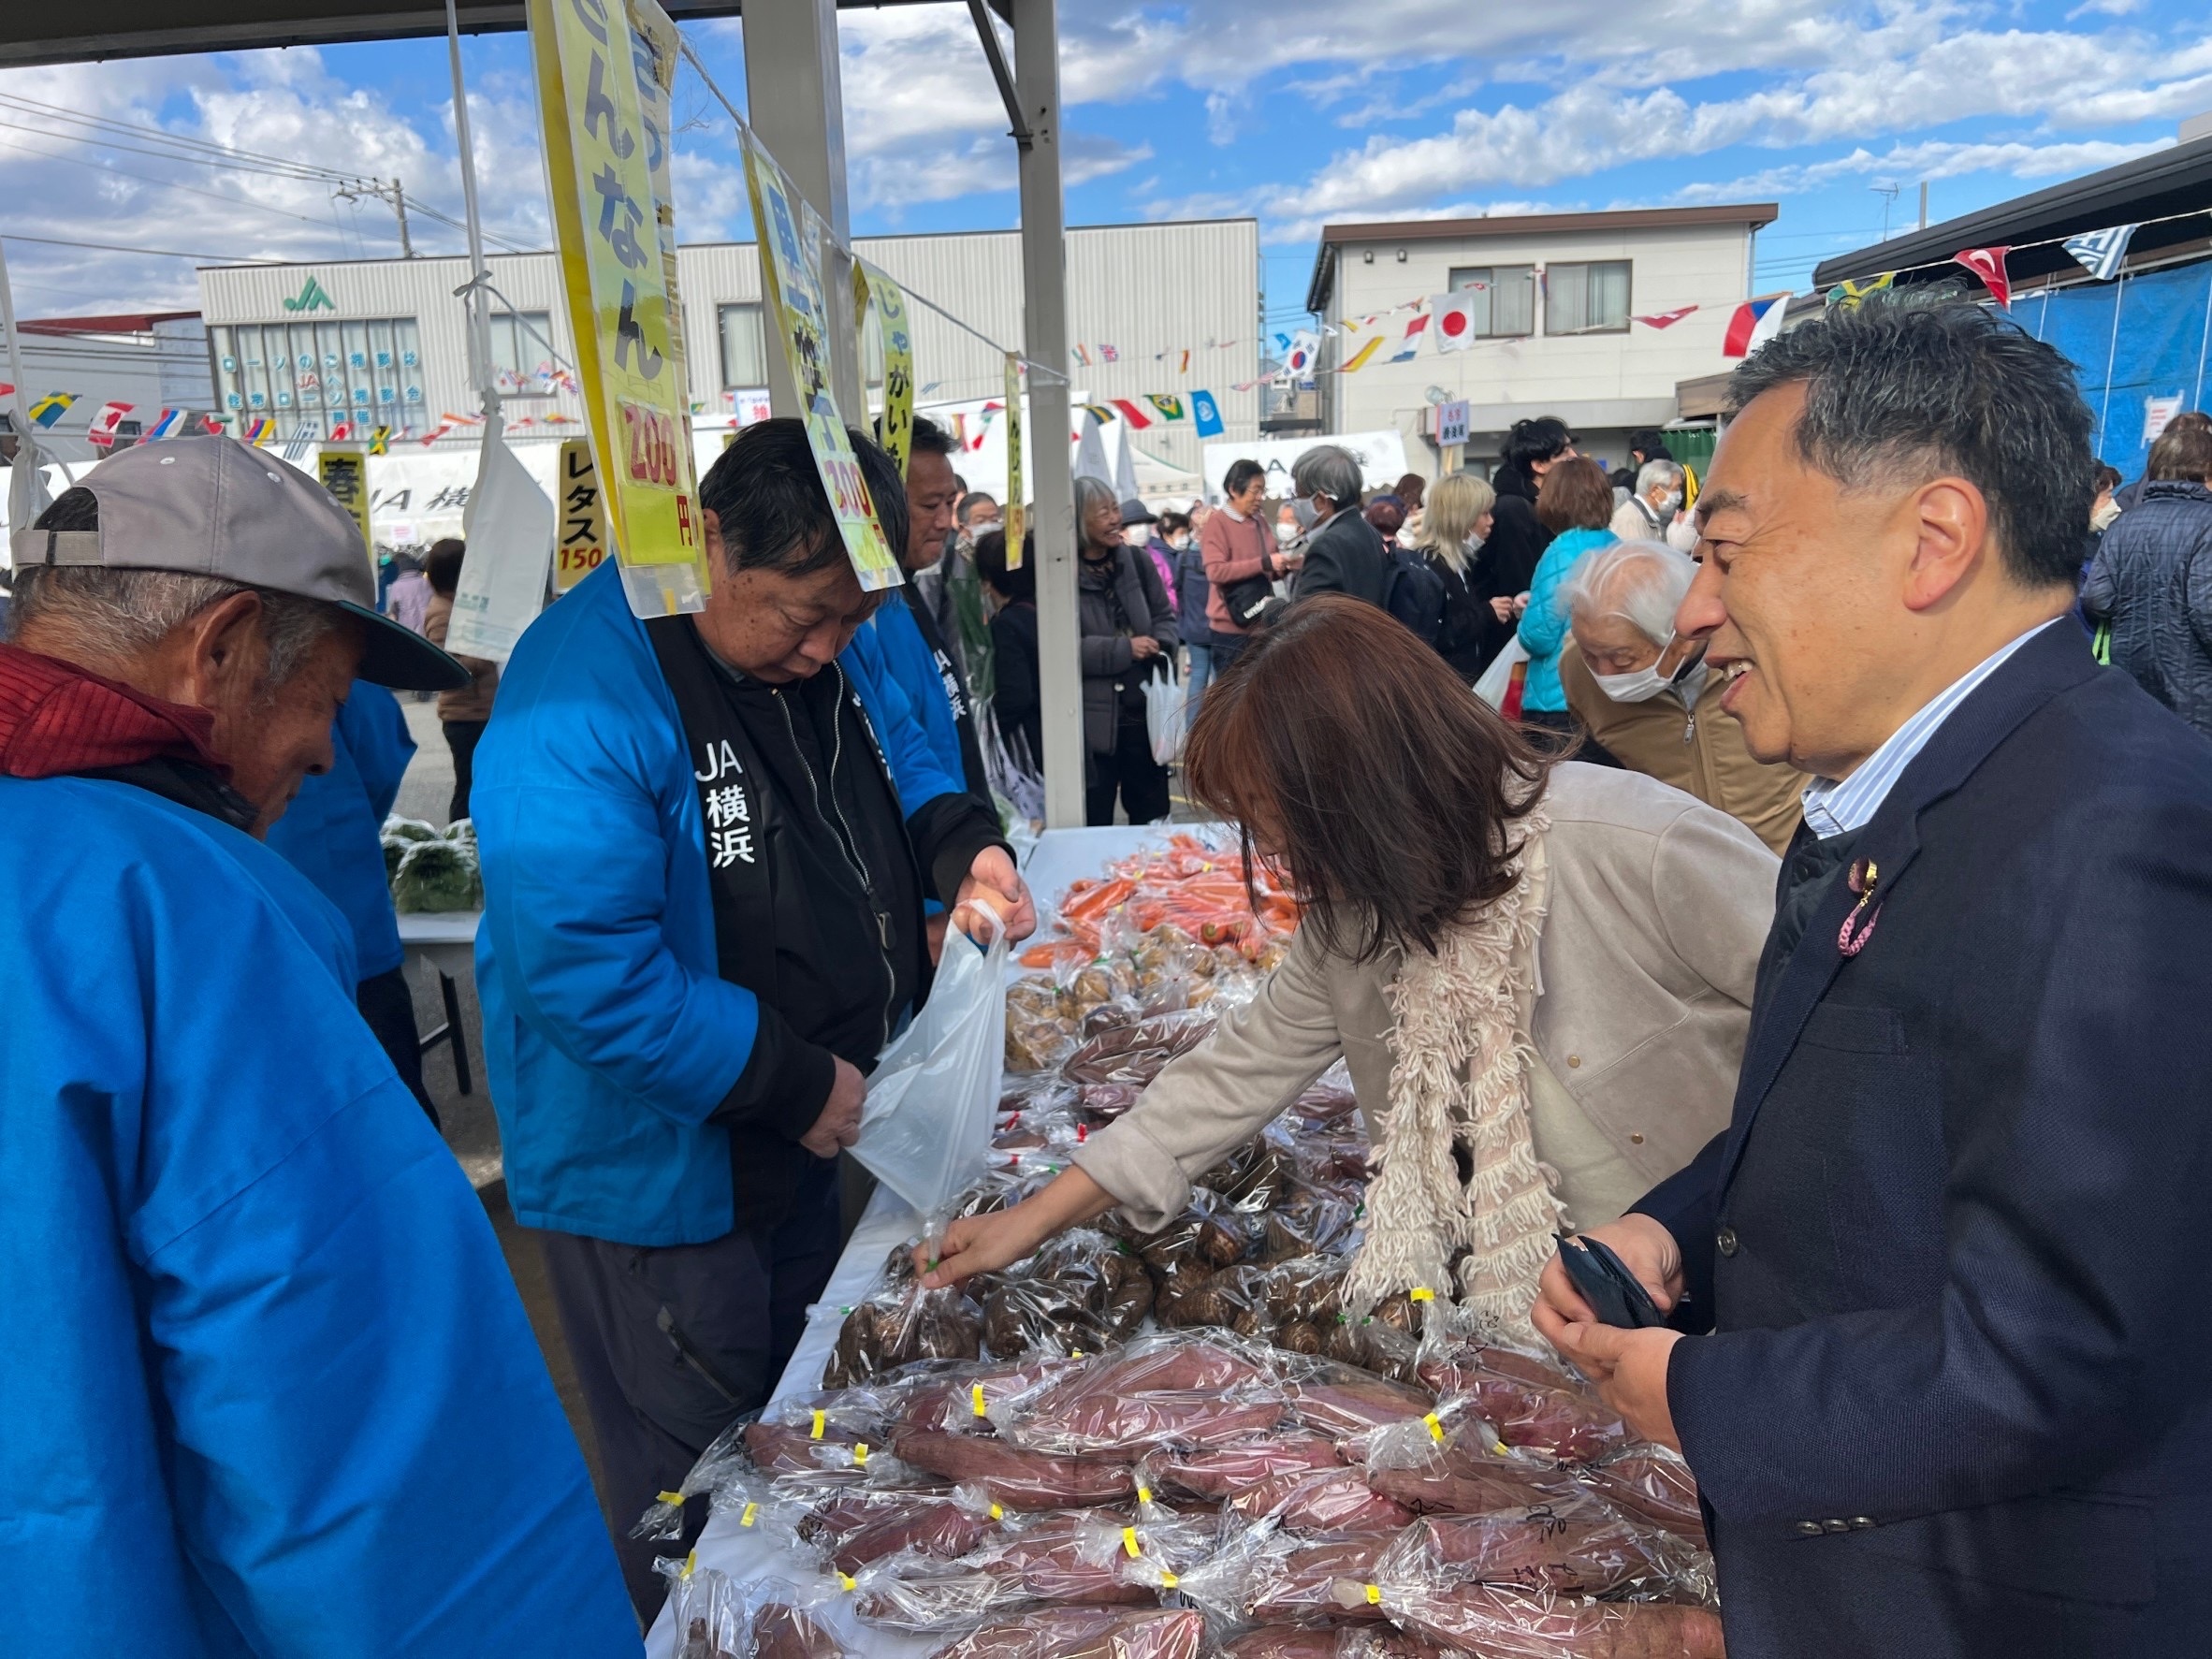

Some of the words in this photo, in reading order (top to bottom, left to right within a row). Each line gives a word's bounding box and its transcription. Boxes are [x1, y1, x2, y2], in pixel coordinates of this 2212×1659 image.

[284, 275, 336, 311] JA
[624, 404, 677, 487] 200
[563, 452, 598, 546] レタス
[823, 459, 872, 517] 300
[677, 495, 693, 546] 円
[560, 546, 603, 570] 150
[694, 738, 745, 782] JA
[706, 783, 756, 869] 横浜
